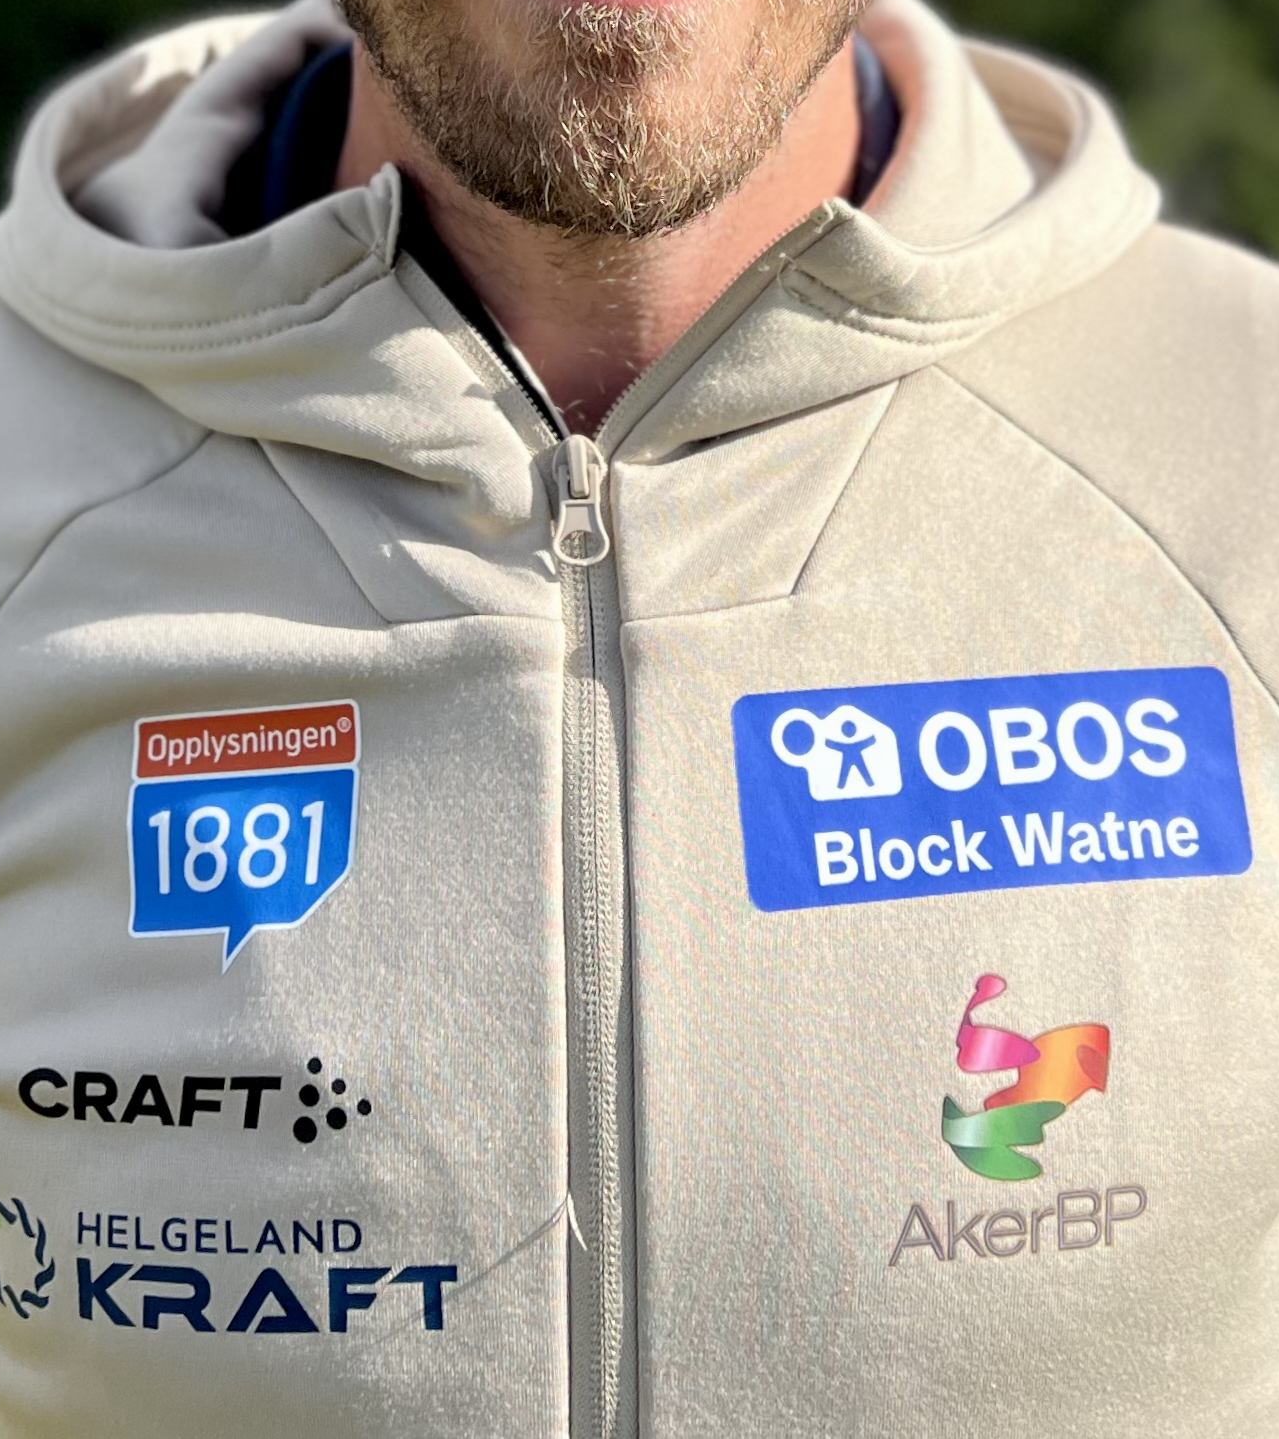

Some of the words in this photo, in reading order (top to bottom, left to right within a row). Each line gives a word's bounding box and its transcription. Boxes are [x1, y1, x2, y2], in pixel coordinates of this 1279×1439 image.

[918, 698, 1187, 792] OBOS
[148, 800, 325, 895] 1881
[813, 819, 993, 887] Block
[1000, 810, 1200, 867] Watne
[18, 1067, 282, 1130] CRAFT
[76, 1211, 363, 1255] HELGELAND
[888, 1185, 1148, 1267] AkerBP
[76, 1257, 458, 1333] KRAFT
